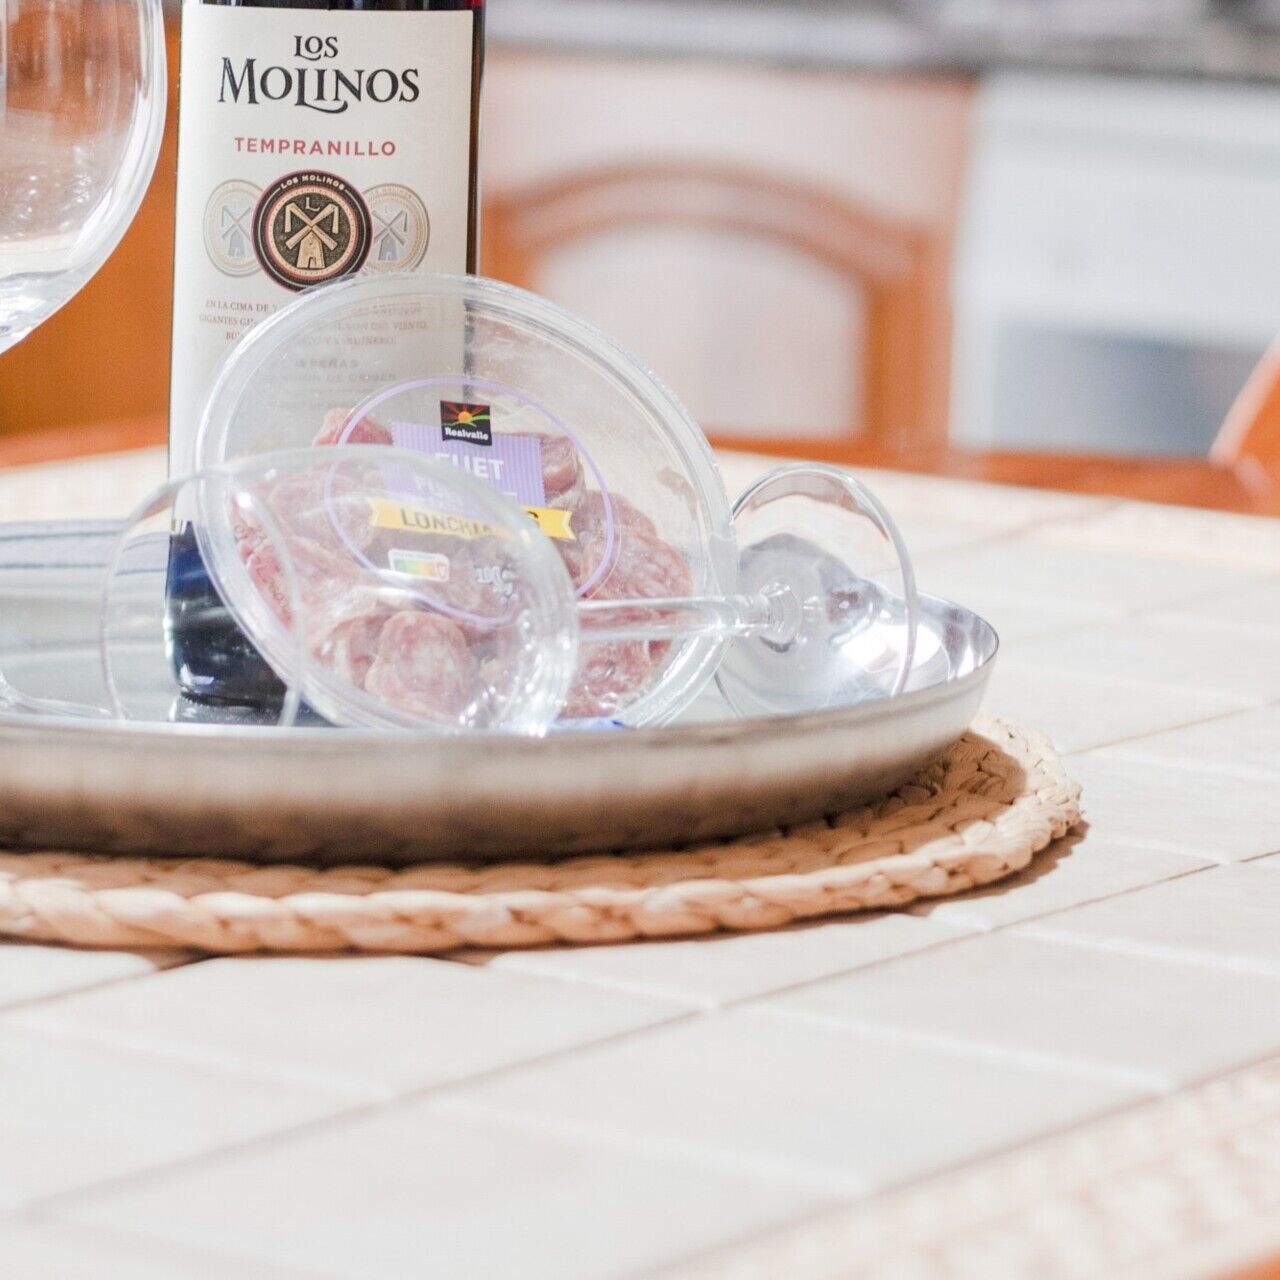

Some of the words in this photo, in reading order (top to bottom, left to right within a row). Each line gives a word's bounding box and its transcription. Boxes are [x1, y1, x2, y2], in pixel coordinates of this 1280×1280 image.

[294, 35, 339, 61] LOS
[218, 57, 420, 114] MOLINOS
[234, 137, 396, 156] TEMPRANILLO
[280, 176, 299, 190] LOS
[301, 174, 346, 191] MOLINOS
[230, 302, 254, 312] CIMA
[256, 303, 270, 313] DE
[198, 314, 239, 327] GIGANTES
[444, 426, 490, 441] Realvalle
